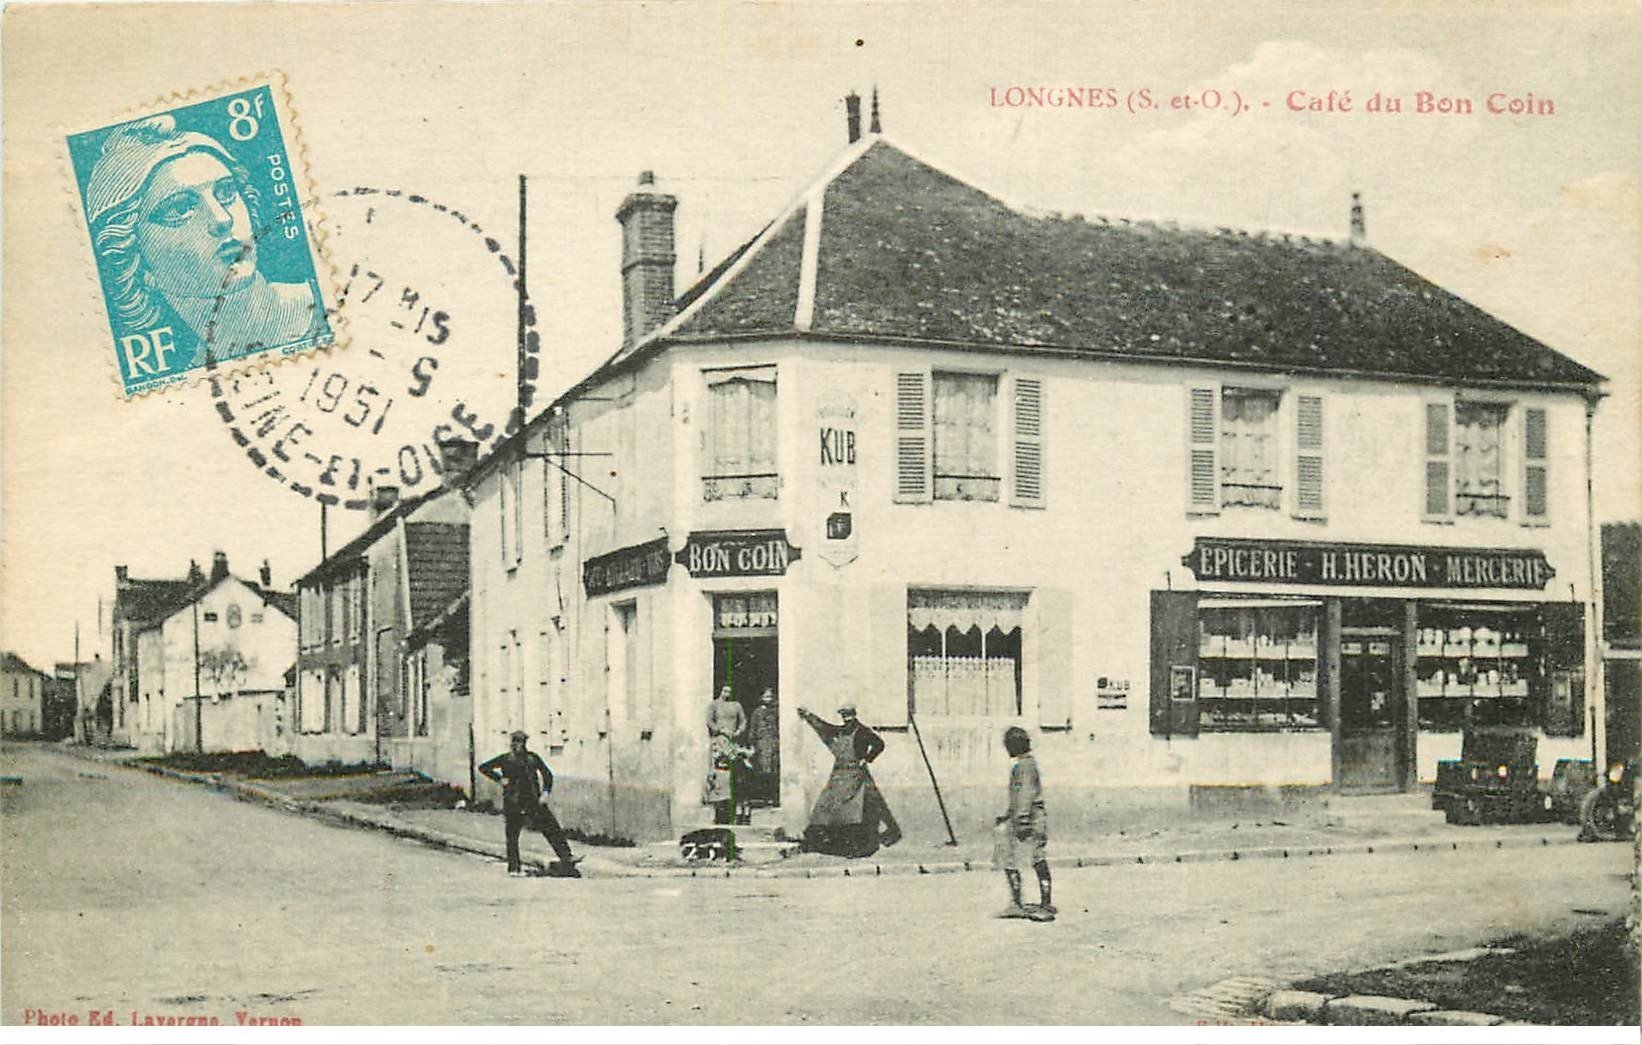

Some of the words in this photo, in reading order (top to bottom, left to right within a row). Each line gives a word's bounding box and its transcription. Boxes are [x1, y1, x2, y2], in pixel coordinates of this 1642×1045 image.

[268, 154, 298, 240] POSTES
[120, 326, 176, 379] RF
[300, 367, 394, 435] 1951
[820, 427, 856, 466] KUB
[689, 543, 730, 572] BON
[738, 541, 789, 571] COIN
[1201, 547, 1298, 578] EPICERIE
[1447, 555, 1545, 585] MERCERIE
